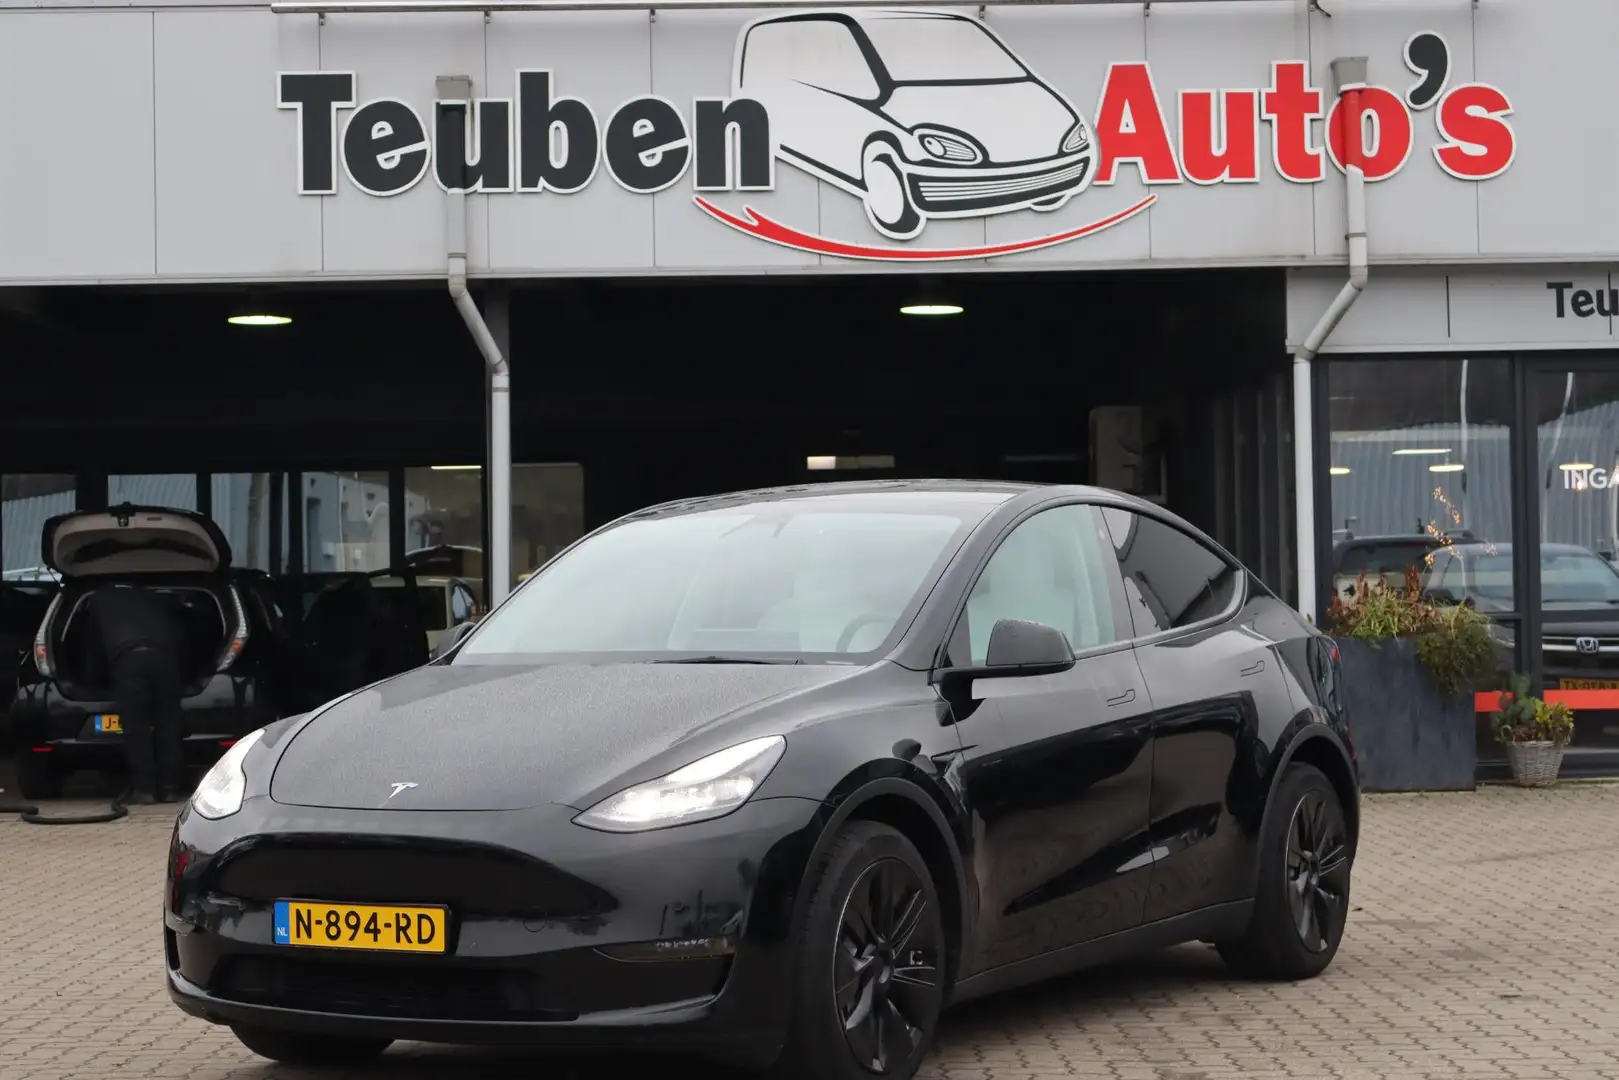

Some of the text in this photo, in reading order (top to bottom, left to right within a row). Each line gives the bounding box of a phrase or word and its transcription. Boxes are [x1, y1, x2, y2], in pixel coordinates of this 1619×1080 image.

[280, 33, 1514, 192] Teuben Auto's
[1546, 281, 1619, 318] Teu
[276, 908, 436, 945] NL N-894-RD
